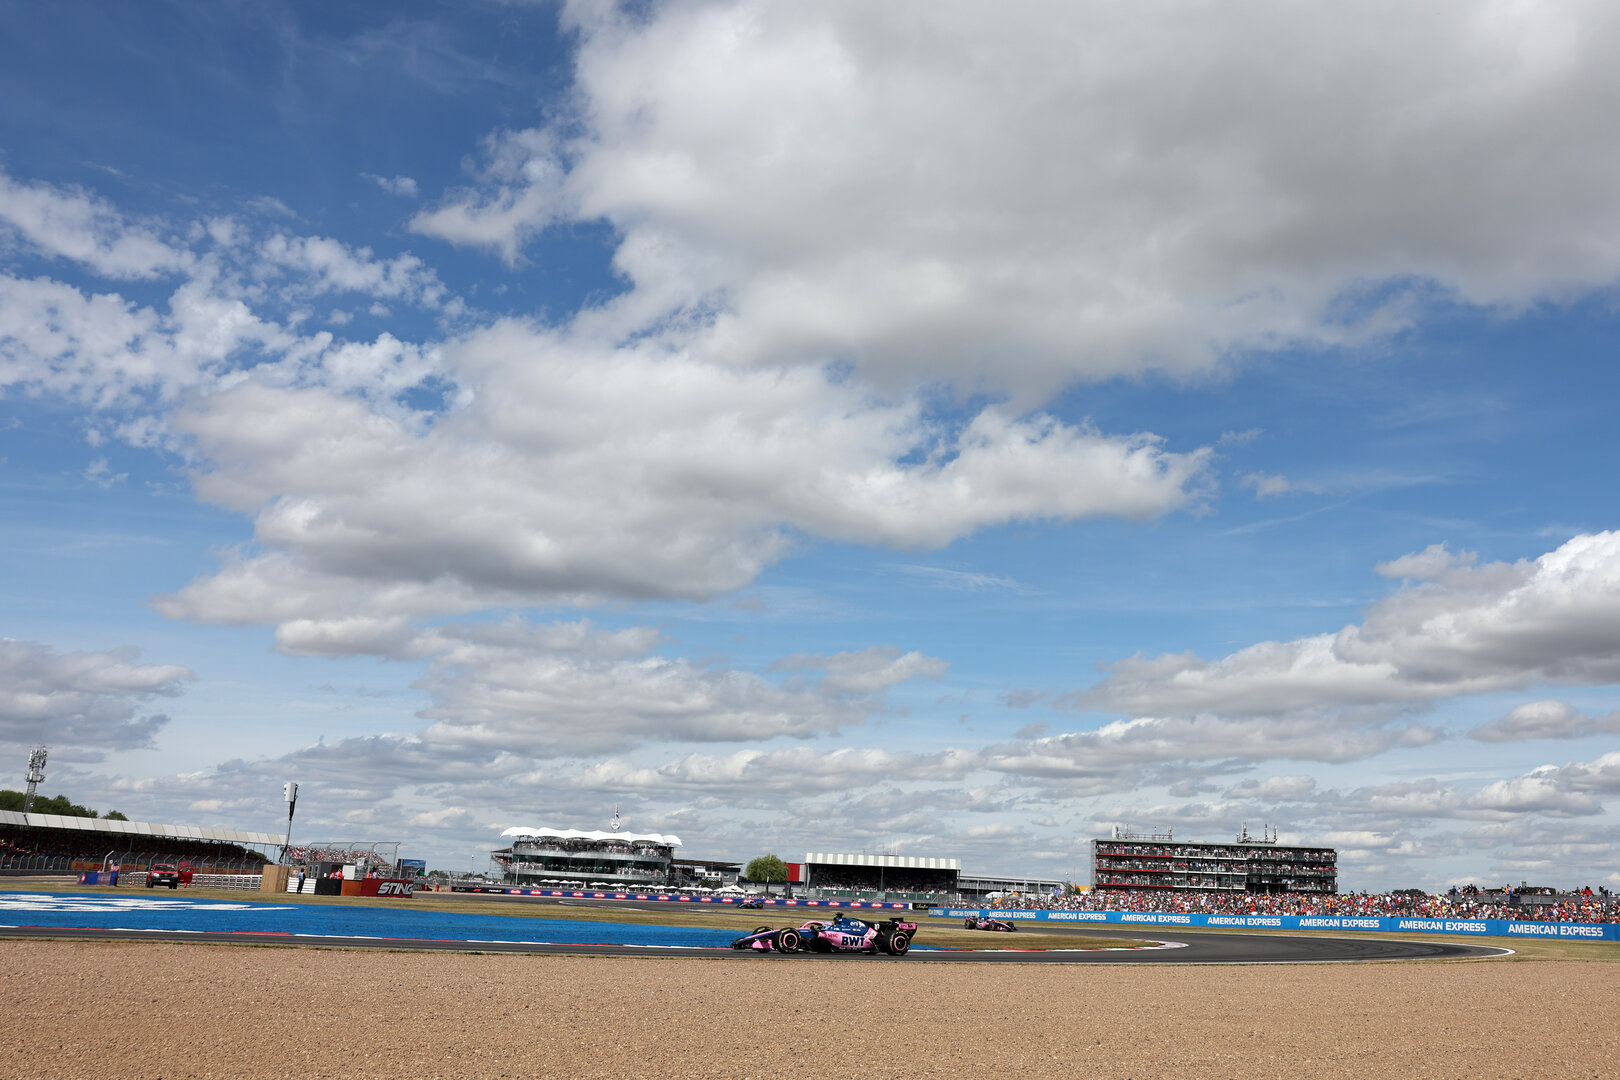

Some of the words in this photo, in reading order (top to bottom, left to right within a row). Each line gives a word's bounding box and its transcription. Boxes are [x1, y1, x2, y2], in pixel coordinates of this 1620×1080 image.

[377, 881, 413, 895] STING
[1121, 914, 1156, 922] AMERICAN
[1158, 915, 1190, 923] EXPRESS
[1207, 917, 1245, 925] AMERICAN
[1247, 918, 1281, 926] EXPRESS
[1299, 918, 1340, 927] AMERICAN
[1342, 919, 1380, 928] EXPRESS
[1399, 920, 1443, 930] AMERICAN
[1445, 922, 1487, 932] EXPRESS
[1508, 924, 1558, 935] AMERICAN
[1560, 926, 1603, 937] EXPRESS
[841, 936, 866, 947] BWT
